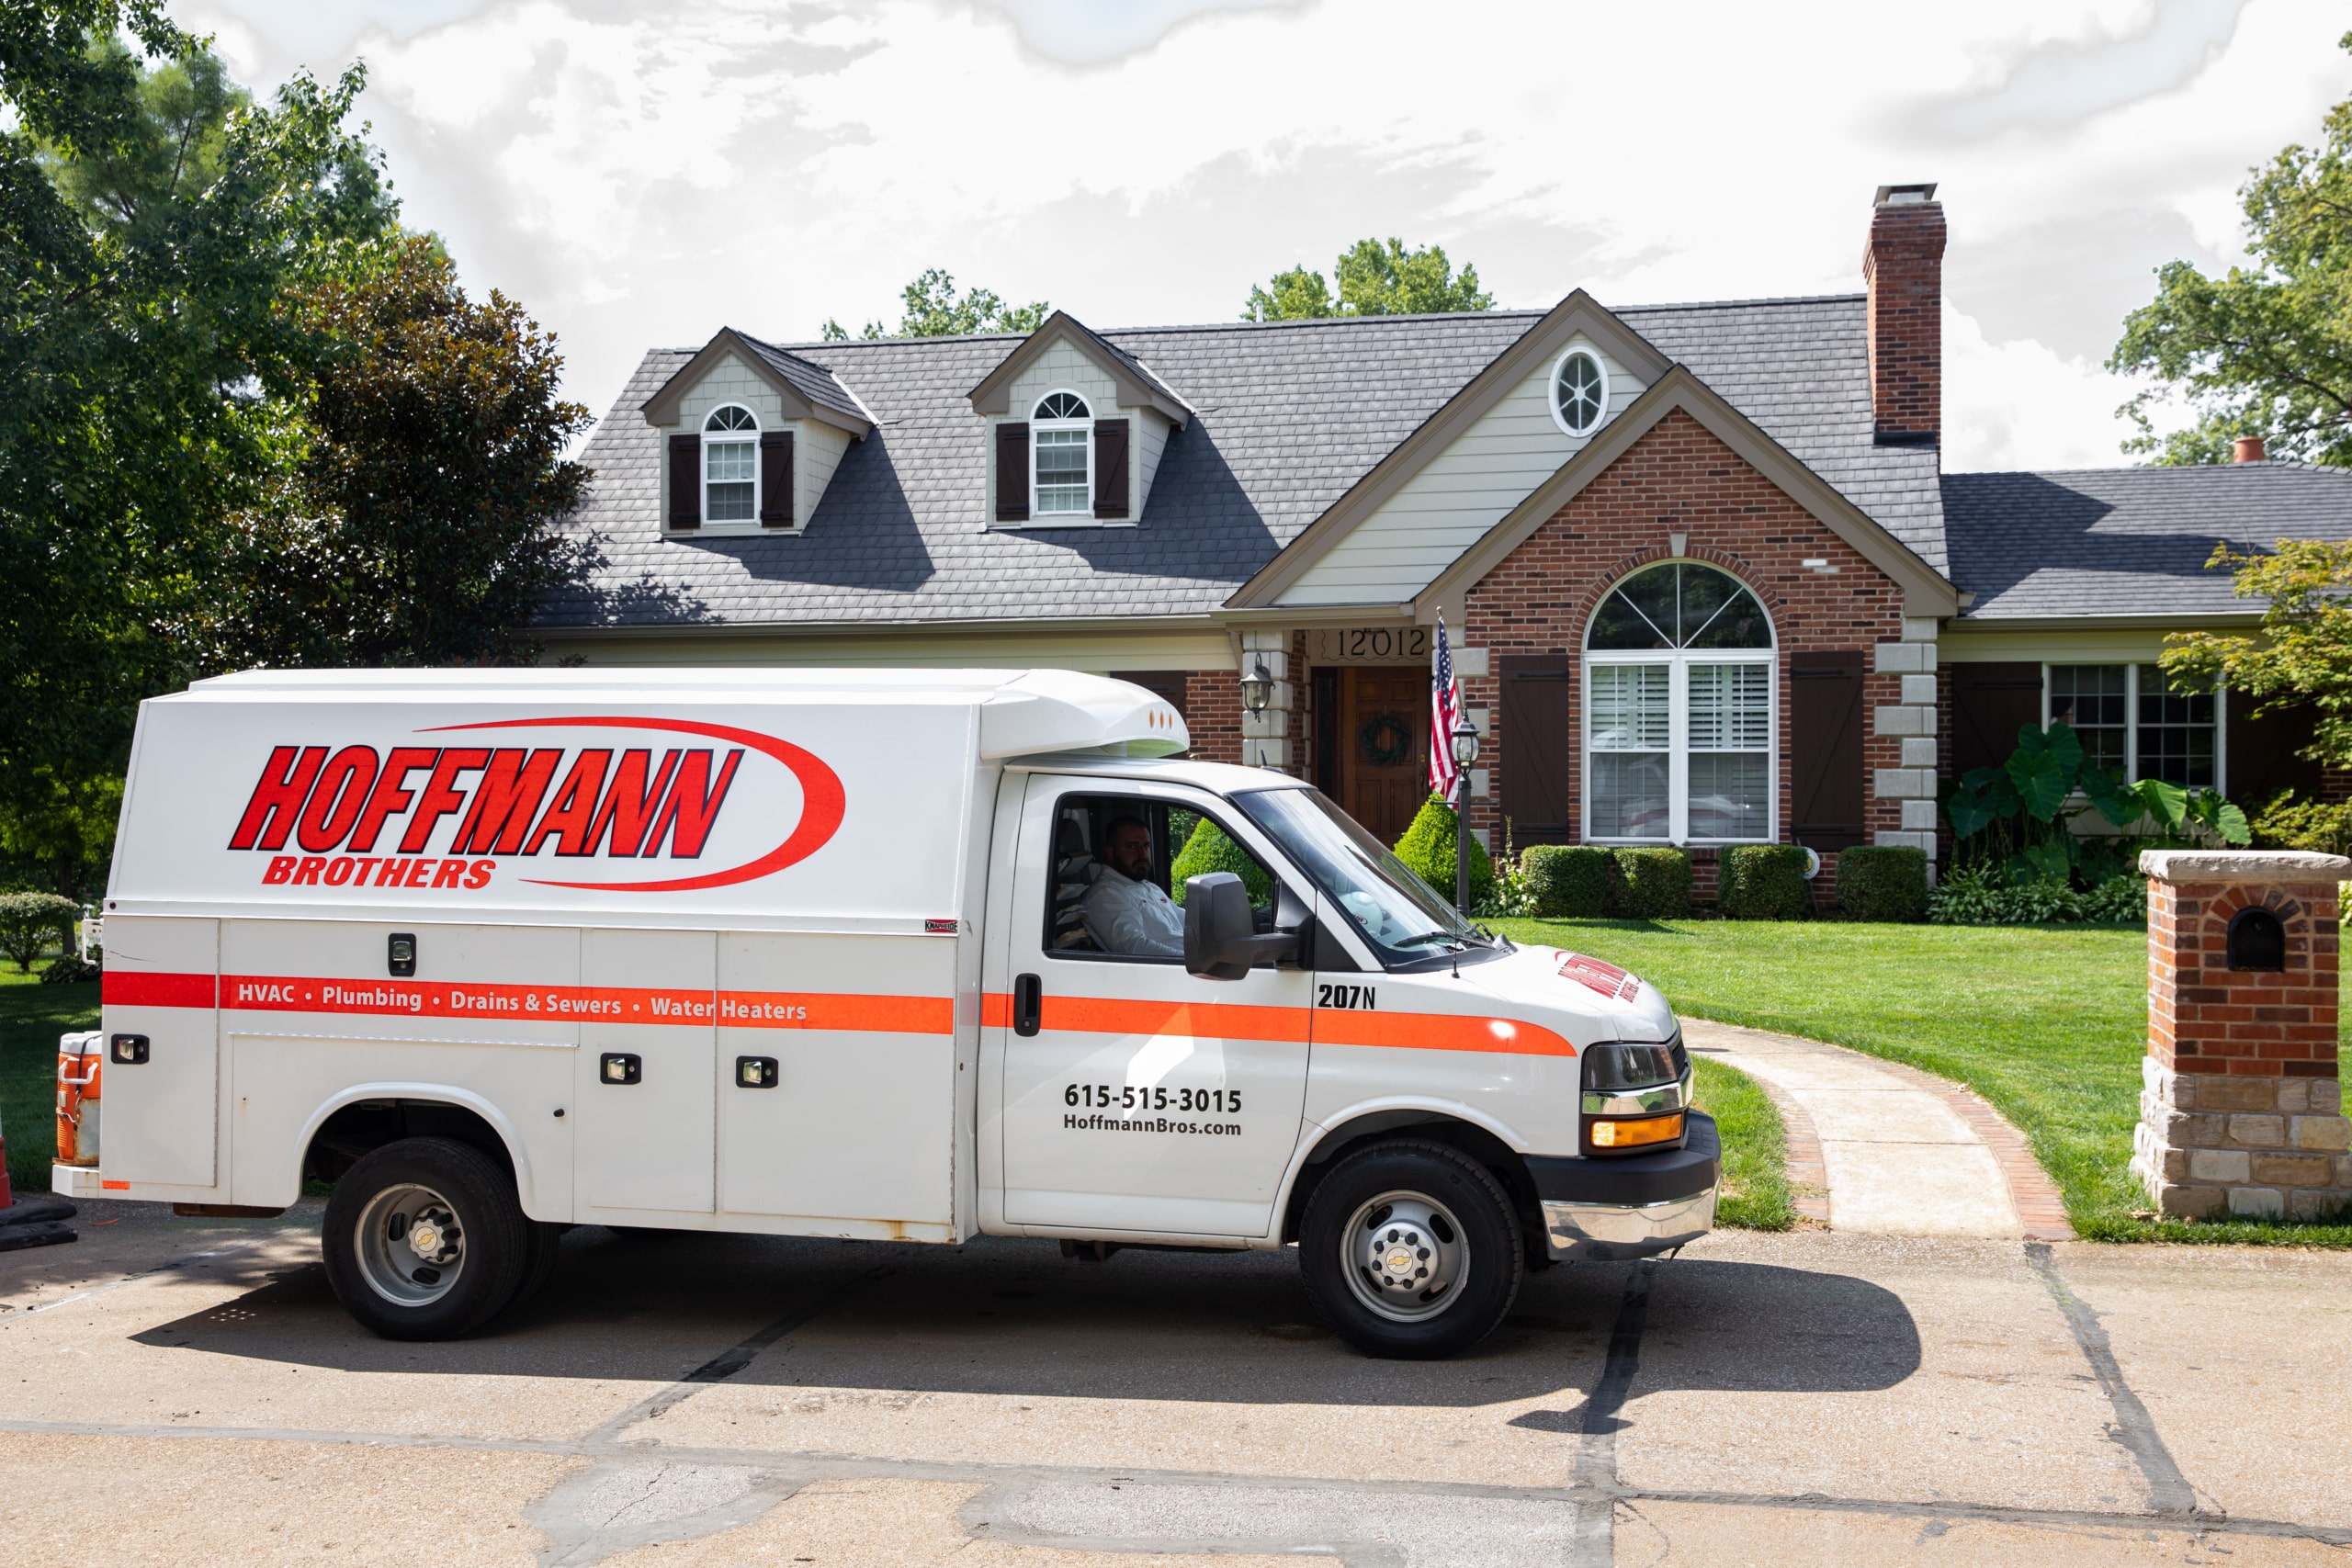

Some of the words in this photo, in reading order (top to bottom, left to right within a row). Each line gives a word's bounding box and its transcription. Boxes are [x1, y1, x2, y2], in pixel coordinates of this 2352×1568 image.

[1339, 628, 1425, 656] 12012
[227, 744, 746, 860] HOFFMANN
[261, 855, 496, 890] BROTHERS
[925, 919, 958, 932] KNAPHEIDE
[239, 984, 295, 1003] HVAC
[322, 986, 422, 1011] Plumbing
[451, 991, 518, 1010] Drains
[525, 993, 540, 1012] &
[546, 994, 621, 1015] Sewers
[650, 997, 716, 1018] Water
[721, 999, 807, 1020] Heaters
[1064, 1083, 1242, 1113] 615-515-3015
[1064, 1113, 1242, 1136] HoffmannBros.com
